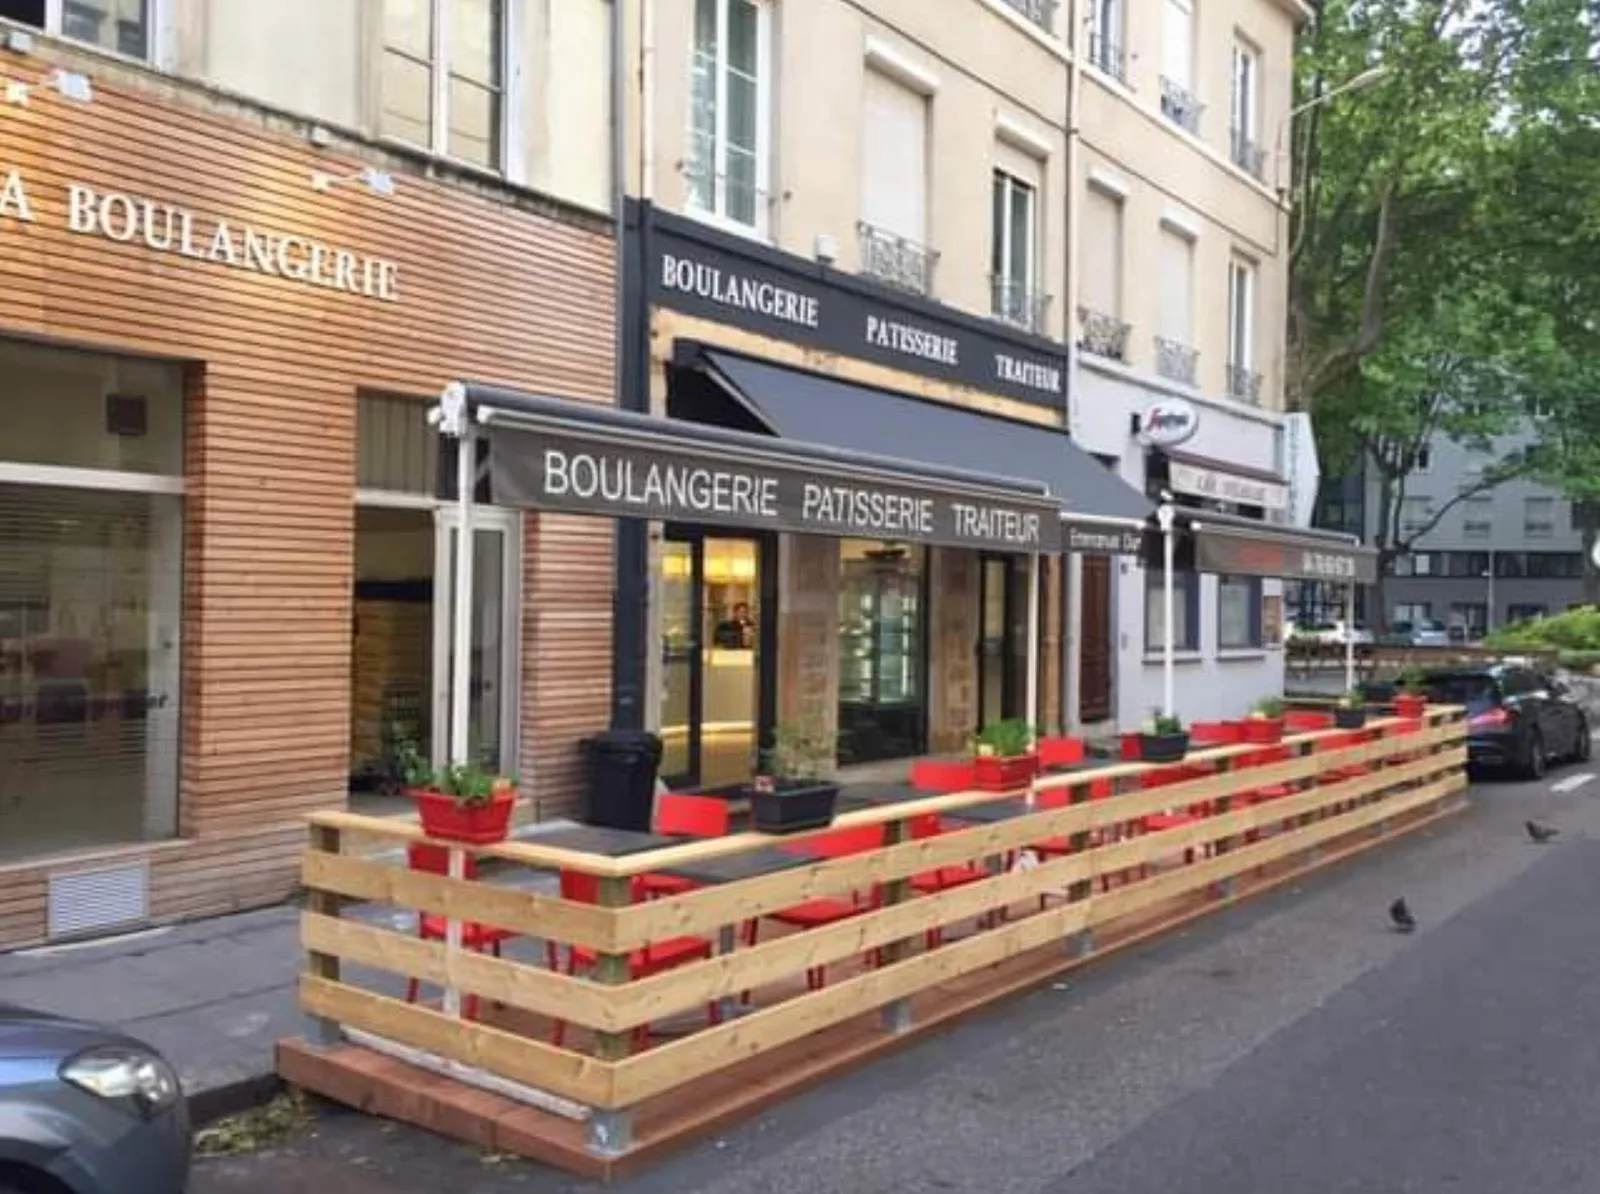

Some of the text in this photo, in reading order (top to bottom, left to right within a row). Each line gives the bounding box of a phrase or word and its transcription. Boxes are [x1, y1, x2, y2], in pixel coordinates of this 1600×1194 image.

[67, 183, 400, 301] BOULANGERIE
[661, 254, 1062, 393] BOULANGERIE PATISSERIE TRAITEUR
[543, 450, 779, 517] BOULANGERIE
[802, 484, 934, 533] PATISSERIE
[952, 502, 1040, 543] TRAITEUR
